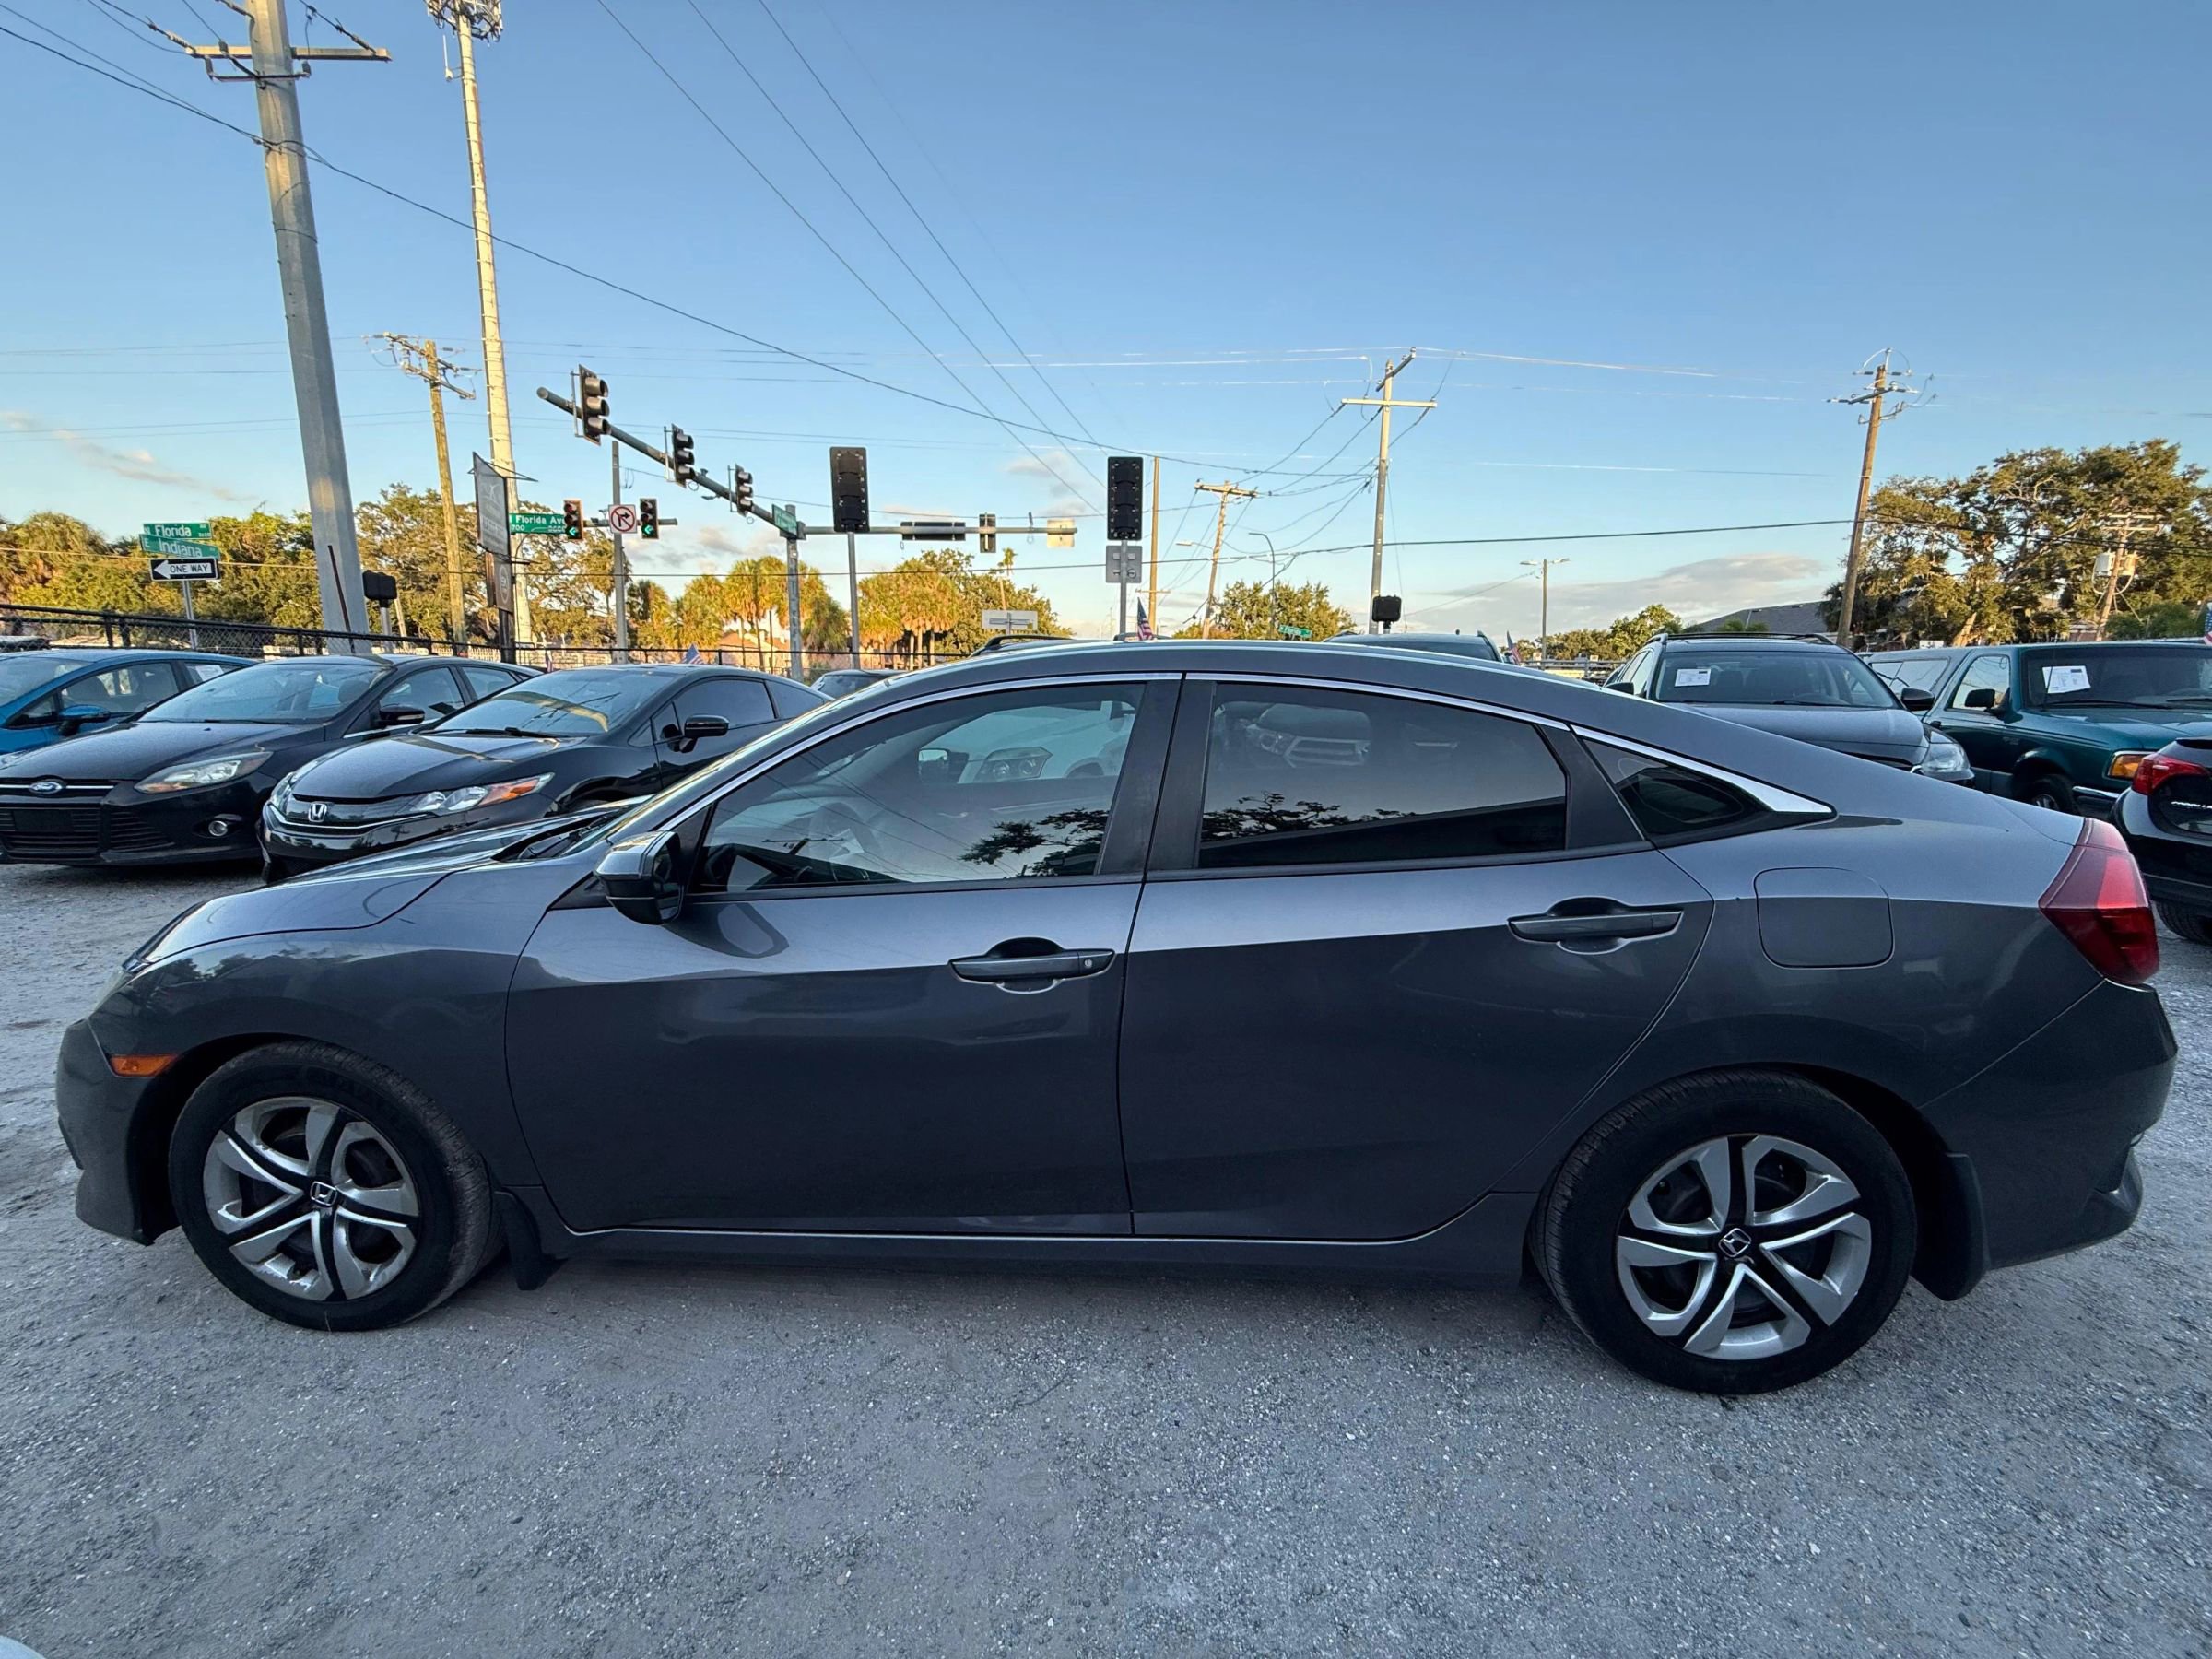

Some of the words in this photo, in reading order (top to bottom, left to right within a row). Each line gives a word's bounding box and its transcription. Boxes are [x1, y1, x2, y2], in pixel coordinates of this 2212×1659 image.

[516, 516, 547, 524] Florida
[155, 524, 192, 537] Florida
[144, 538, 150, 547] E
[159, 538, 203, 558] Indiana
[170, 565, 188, 573] ONE
[190, 564, 208, 572] WAY
